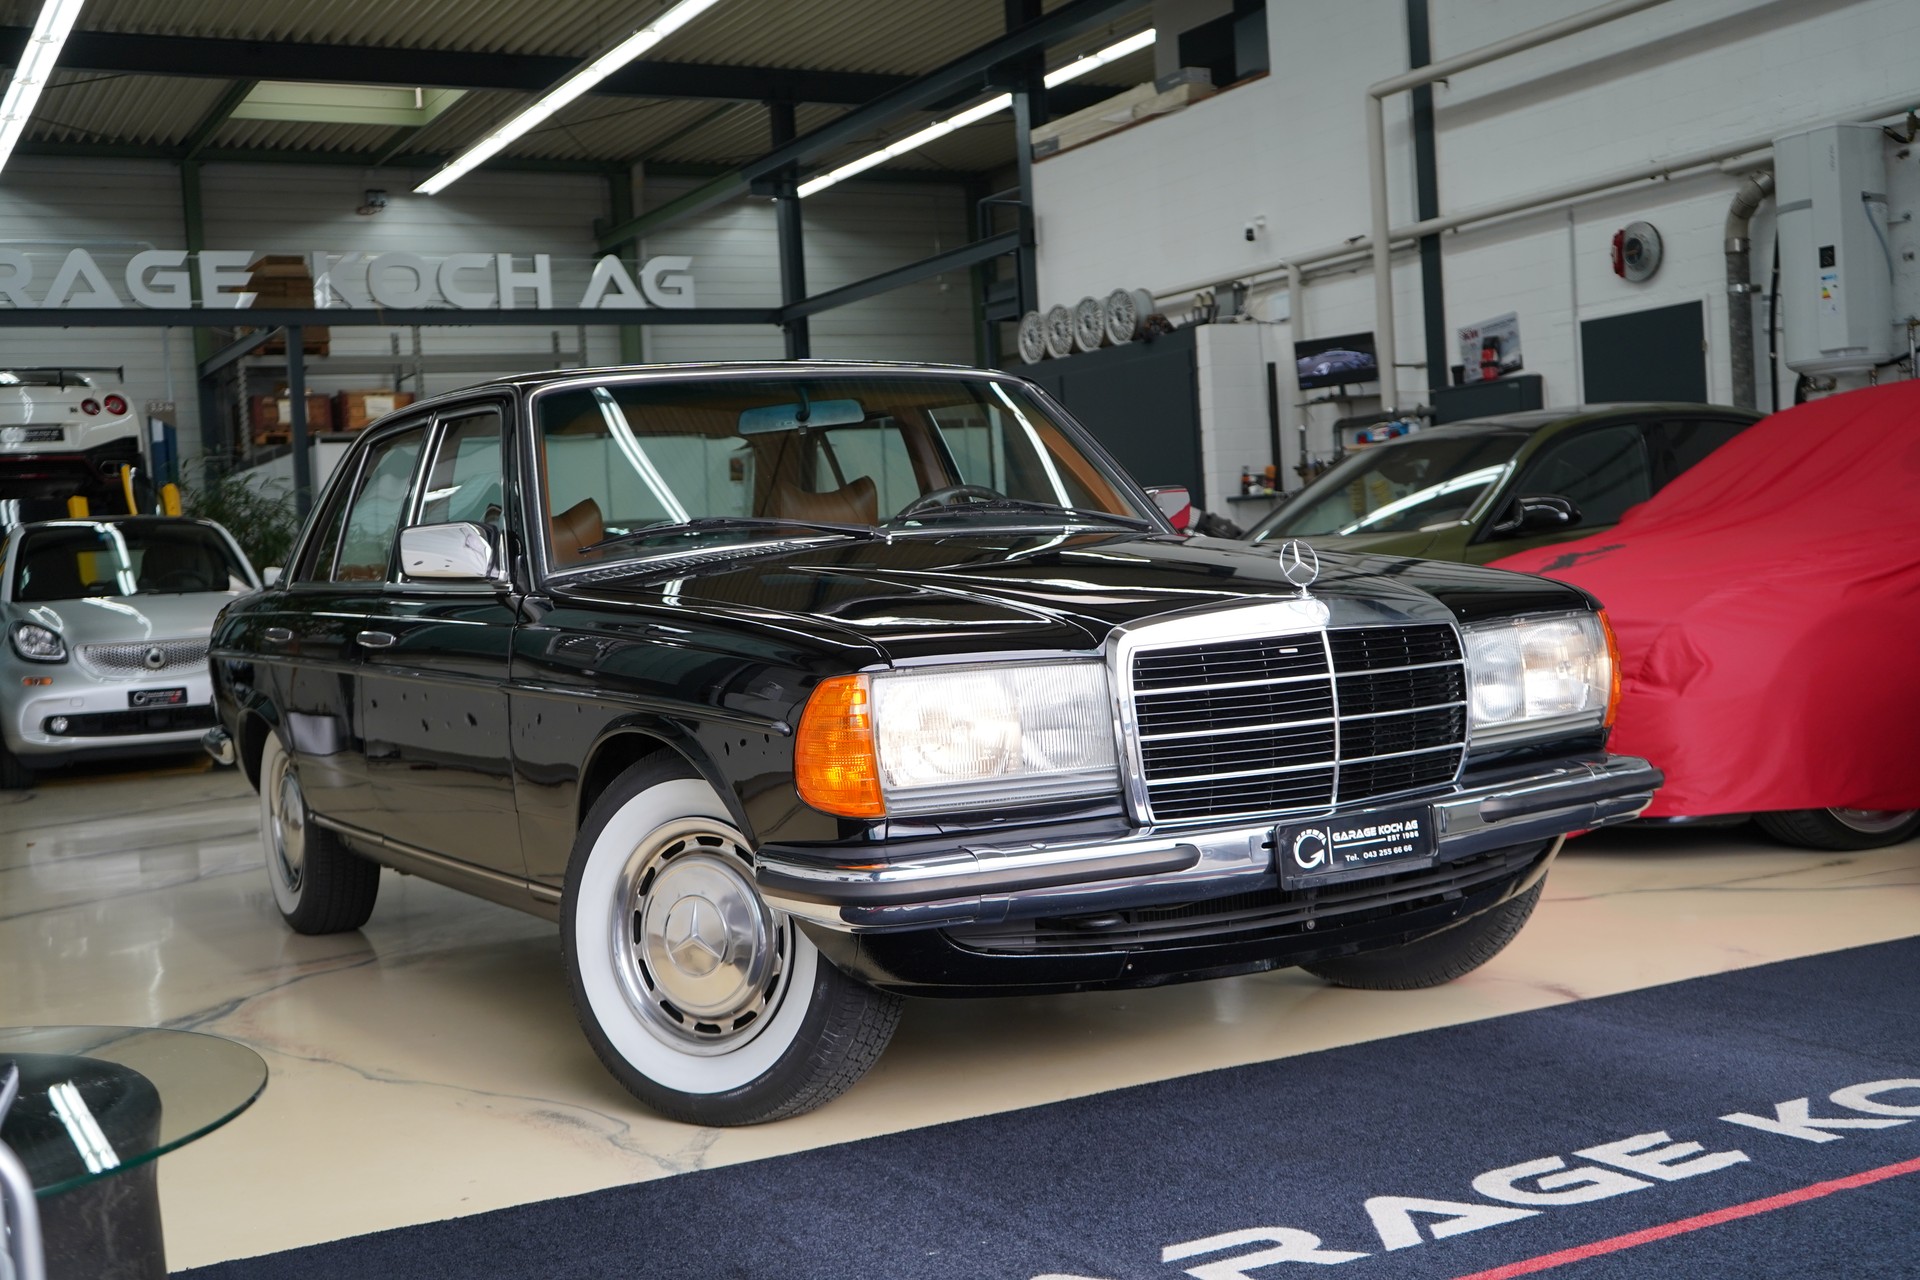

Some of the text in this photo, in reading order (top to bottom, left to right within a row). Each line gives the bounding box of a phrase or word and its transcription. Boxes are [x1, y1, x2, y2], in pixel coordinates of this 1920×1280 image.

[0, 248, 697, 309] RAGE KOCH AG
[1332, 819, 1419, 842] GARAGE KOCH AG
[1387, 833, 1401, 842] EST
[1345, 853, 1360, 862] Tel.
[1363, 850, 1378, 859] 043
[1393, 845, 1403, 854] 66
[1403, 844, 1413, 853] 66
[1030, 1131, 1751, 1280] RAGE
